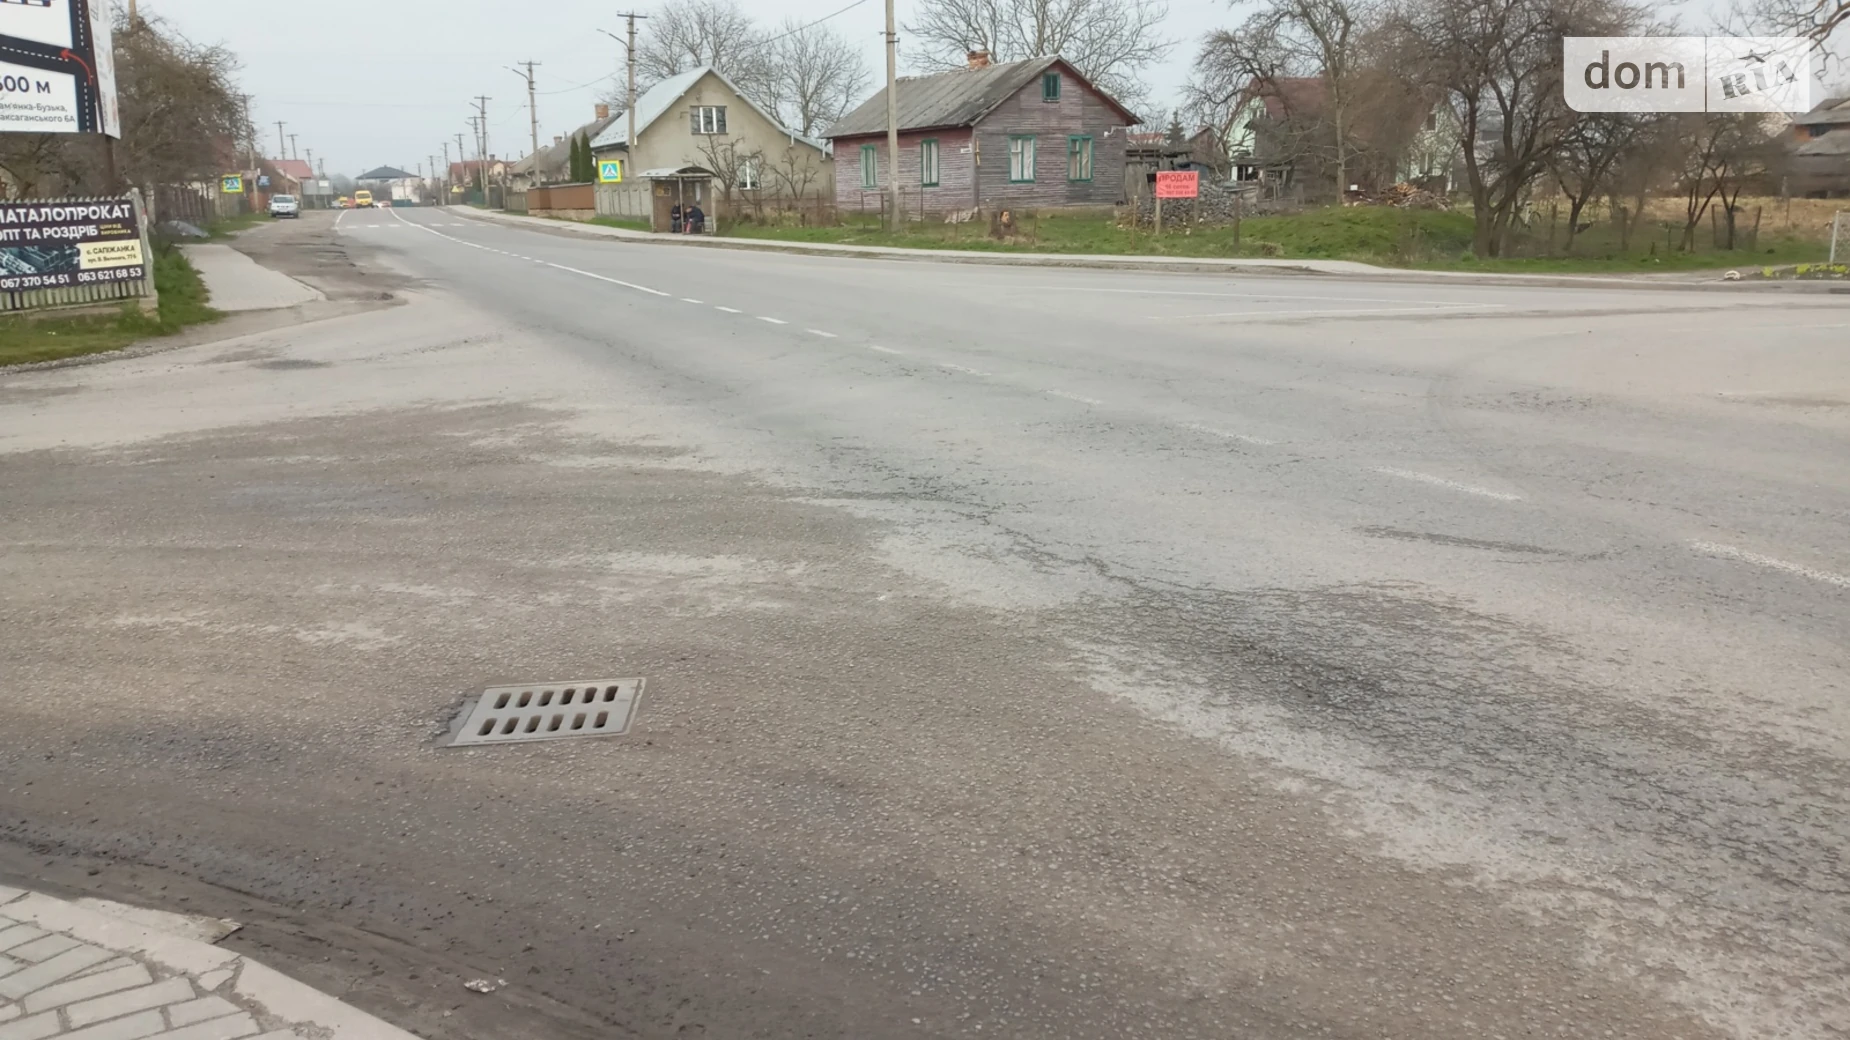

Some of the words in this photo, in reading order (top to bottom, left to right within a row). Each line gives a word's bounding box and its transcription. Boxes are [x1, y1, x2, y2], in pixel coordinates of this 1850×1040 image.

[1158, 174, 1195, 182] ПРОДАМ
[22, 227, 42, 240] ТА
[42, 225, 98, 240] РОЗДРІБ
[1, 277, 20, 289] 067
[22, 276, 41, 287] 370
[43, 275, 57, 285] 54
[58, 274, 70, 284] 51
[77, 271, 96, 282] 063
[97, 270, 114, 280] 621
[115, 269, 128, 278] 68
[129, 268, 142, 277] 53
